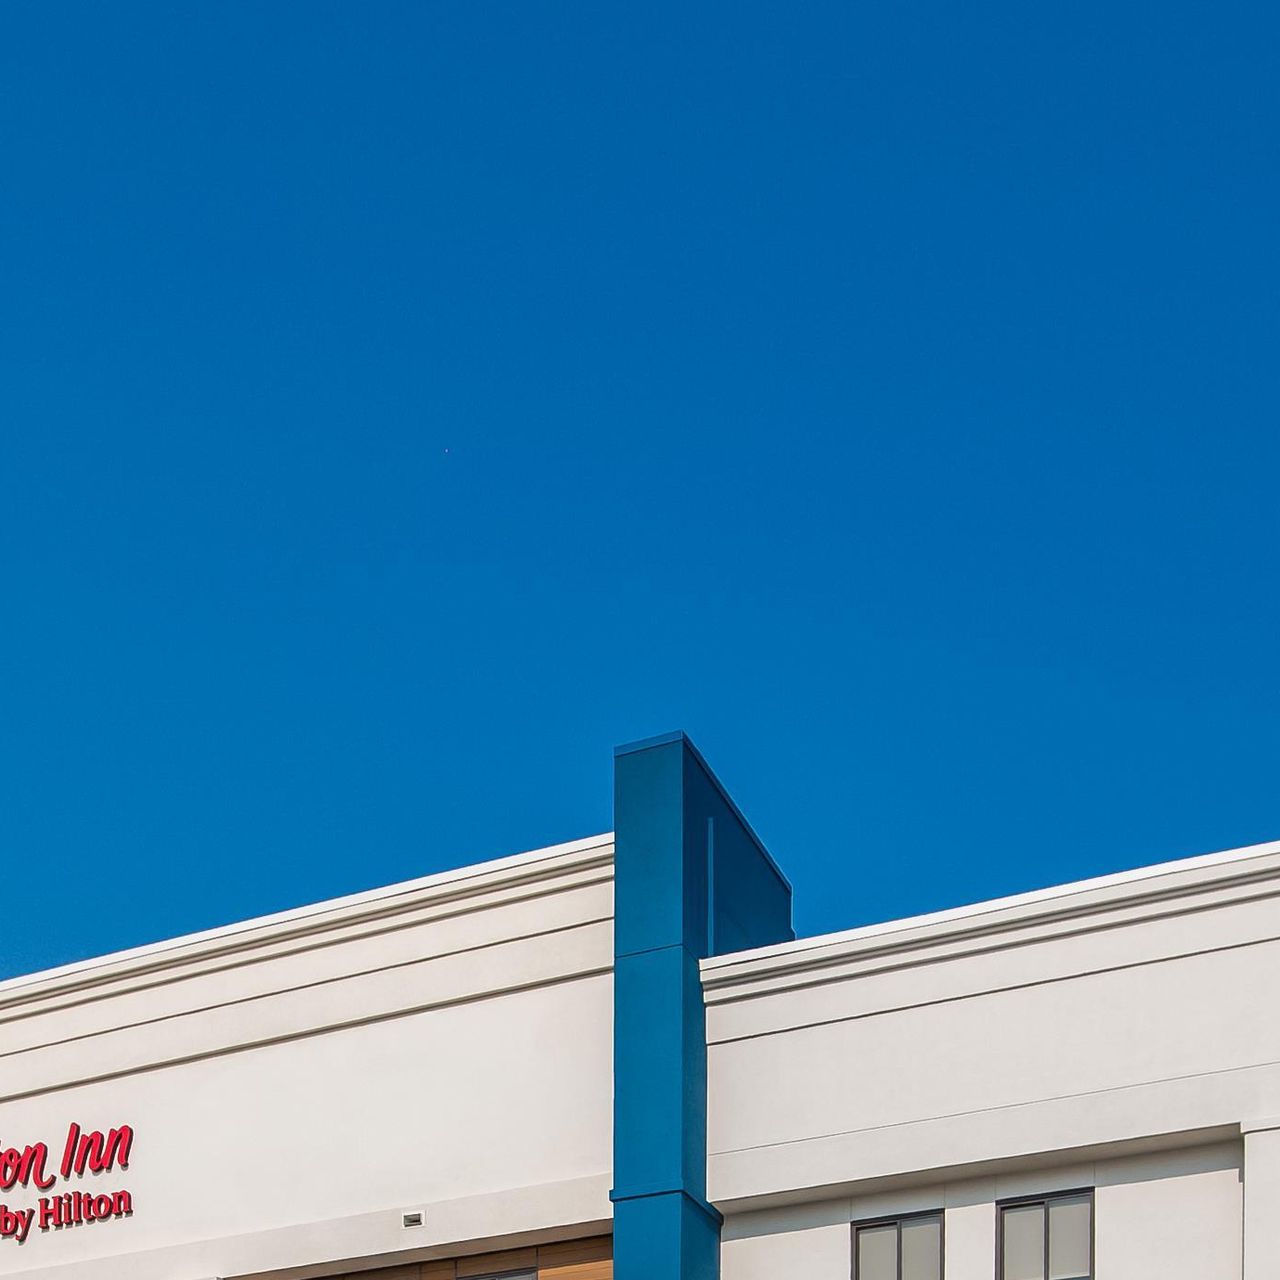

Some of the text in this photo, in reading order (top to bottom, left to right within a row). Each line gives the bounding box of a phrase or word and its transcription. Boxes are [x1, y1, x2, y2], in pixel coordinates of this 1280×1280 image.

[60, 1122, 134, 1178] Inn
[0, 1190, 133, 1242] by Hilton
